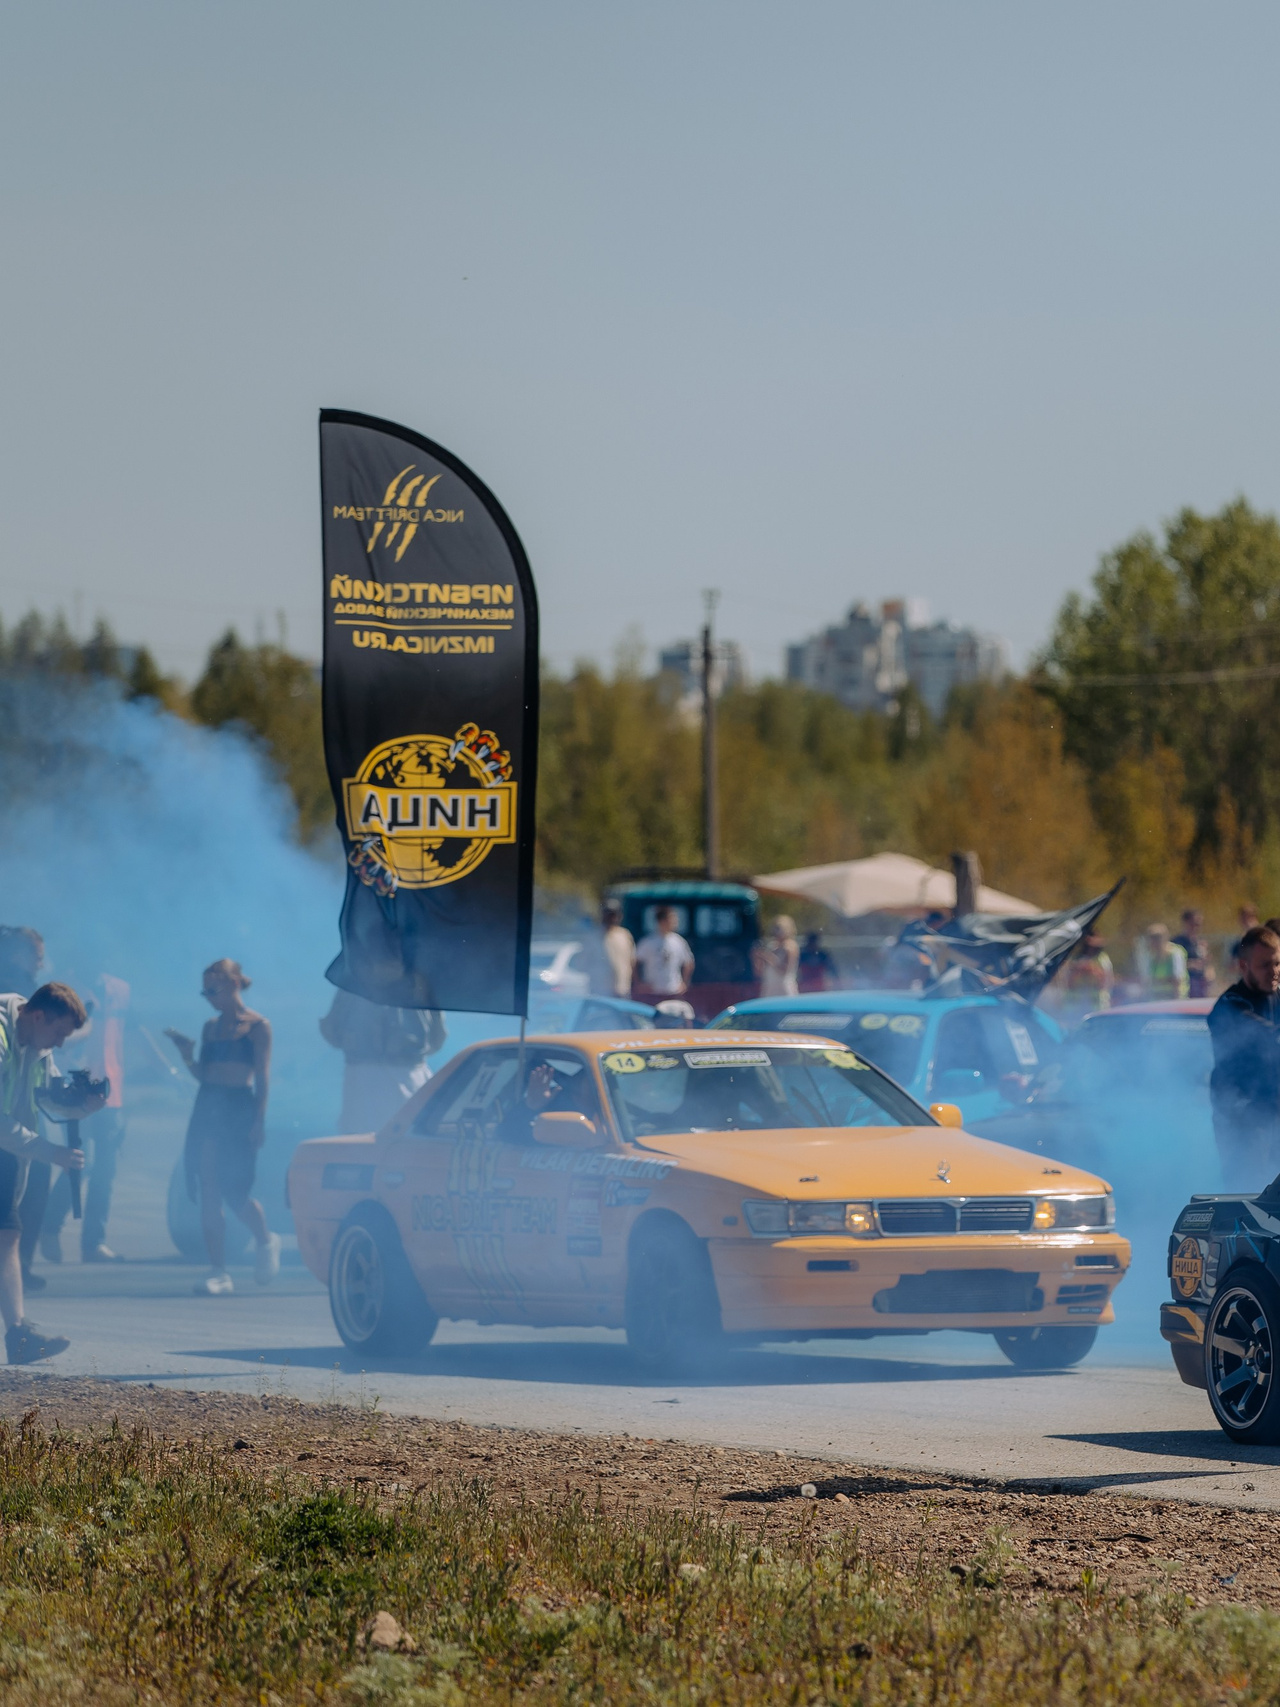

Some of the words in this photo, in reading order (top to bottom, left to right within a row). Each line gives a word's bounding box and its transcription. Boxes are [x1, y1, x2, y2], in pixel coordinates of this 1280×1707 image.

[615, 1058, 636, 1069] 14
[519, 1150, 572, 1172] VILAR
[412, 1195, 457, 1233] NICA
[1175, 1260, 1199, 1274] НИЦА
